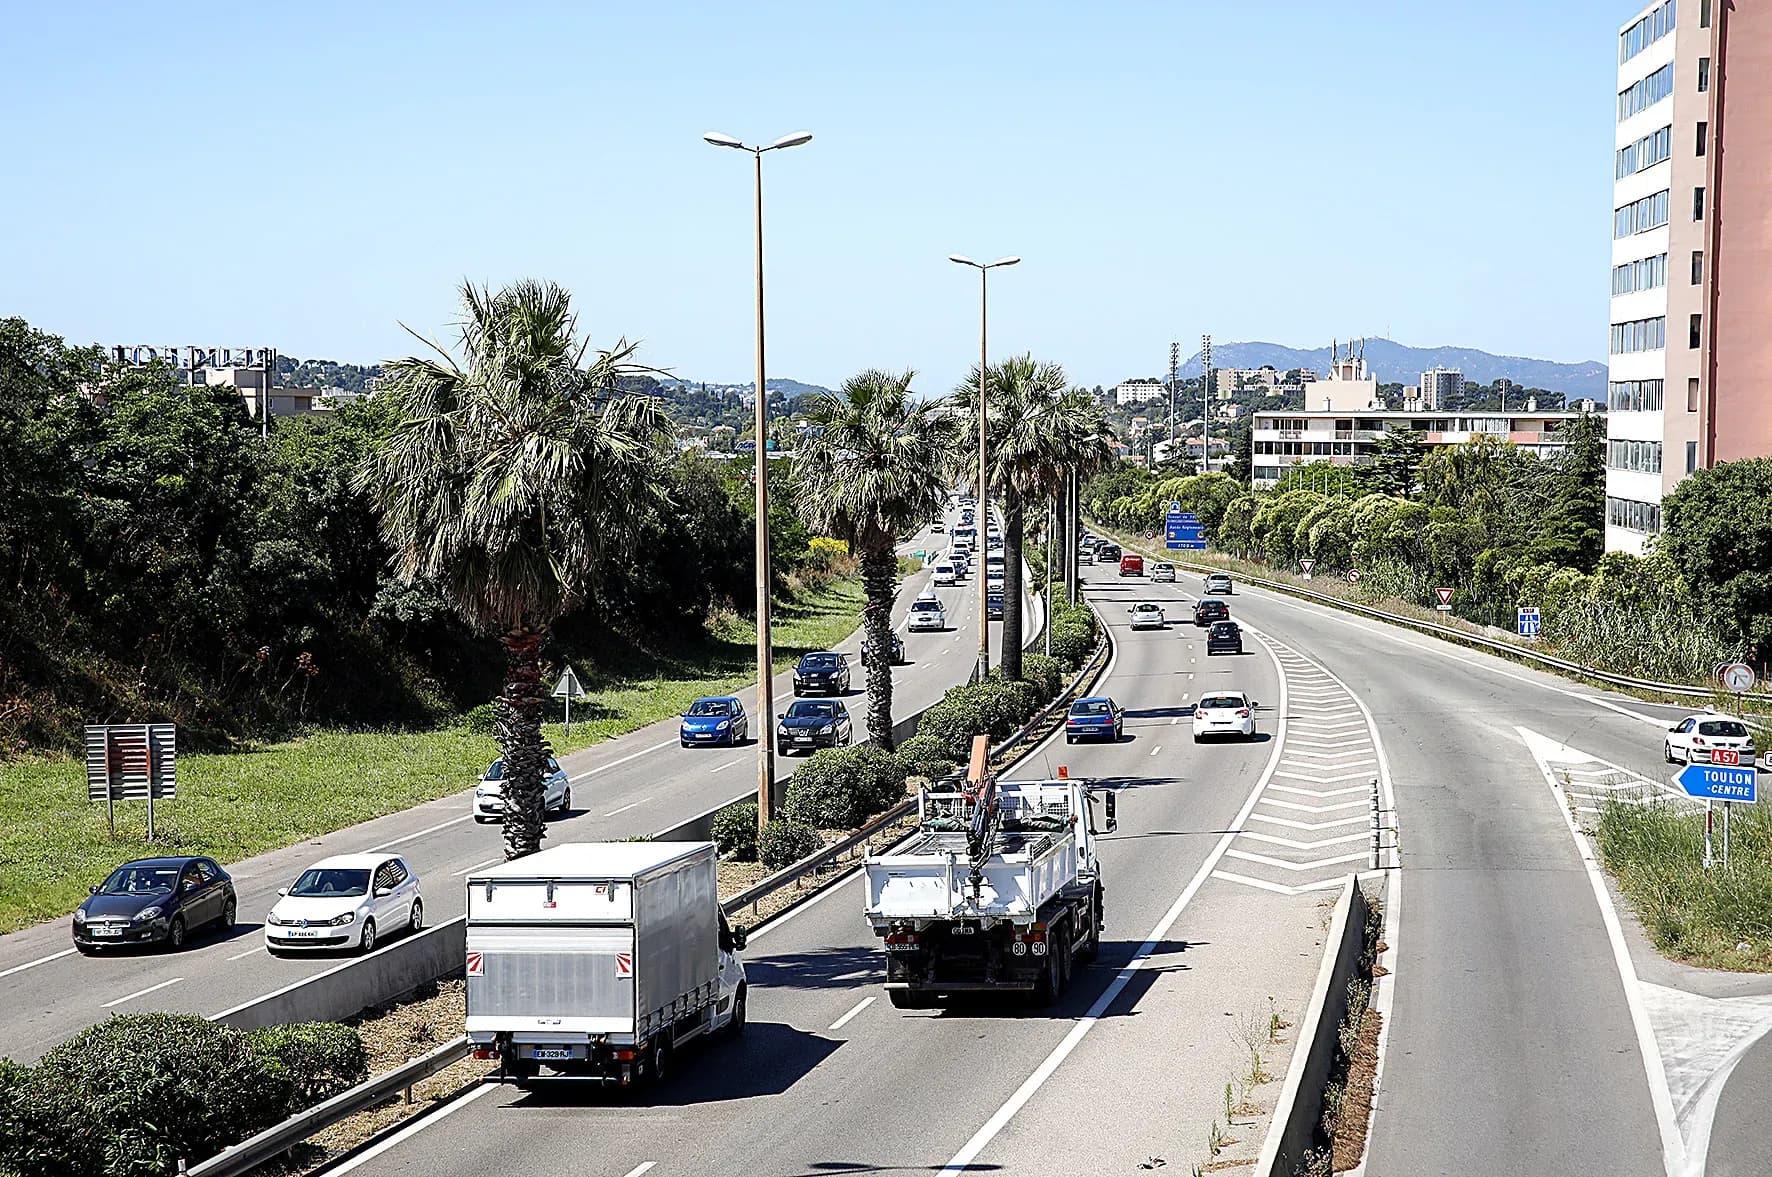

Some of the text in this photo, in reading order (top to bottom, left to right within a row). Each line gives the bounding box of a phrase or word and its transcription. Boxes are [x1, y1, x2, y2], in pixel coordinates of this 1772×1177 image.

[1704, 770, 1752, 785] TOULON
[1014, 942, 1025, 955] 80
[1033, 942, 1045, 955] 90
